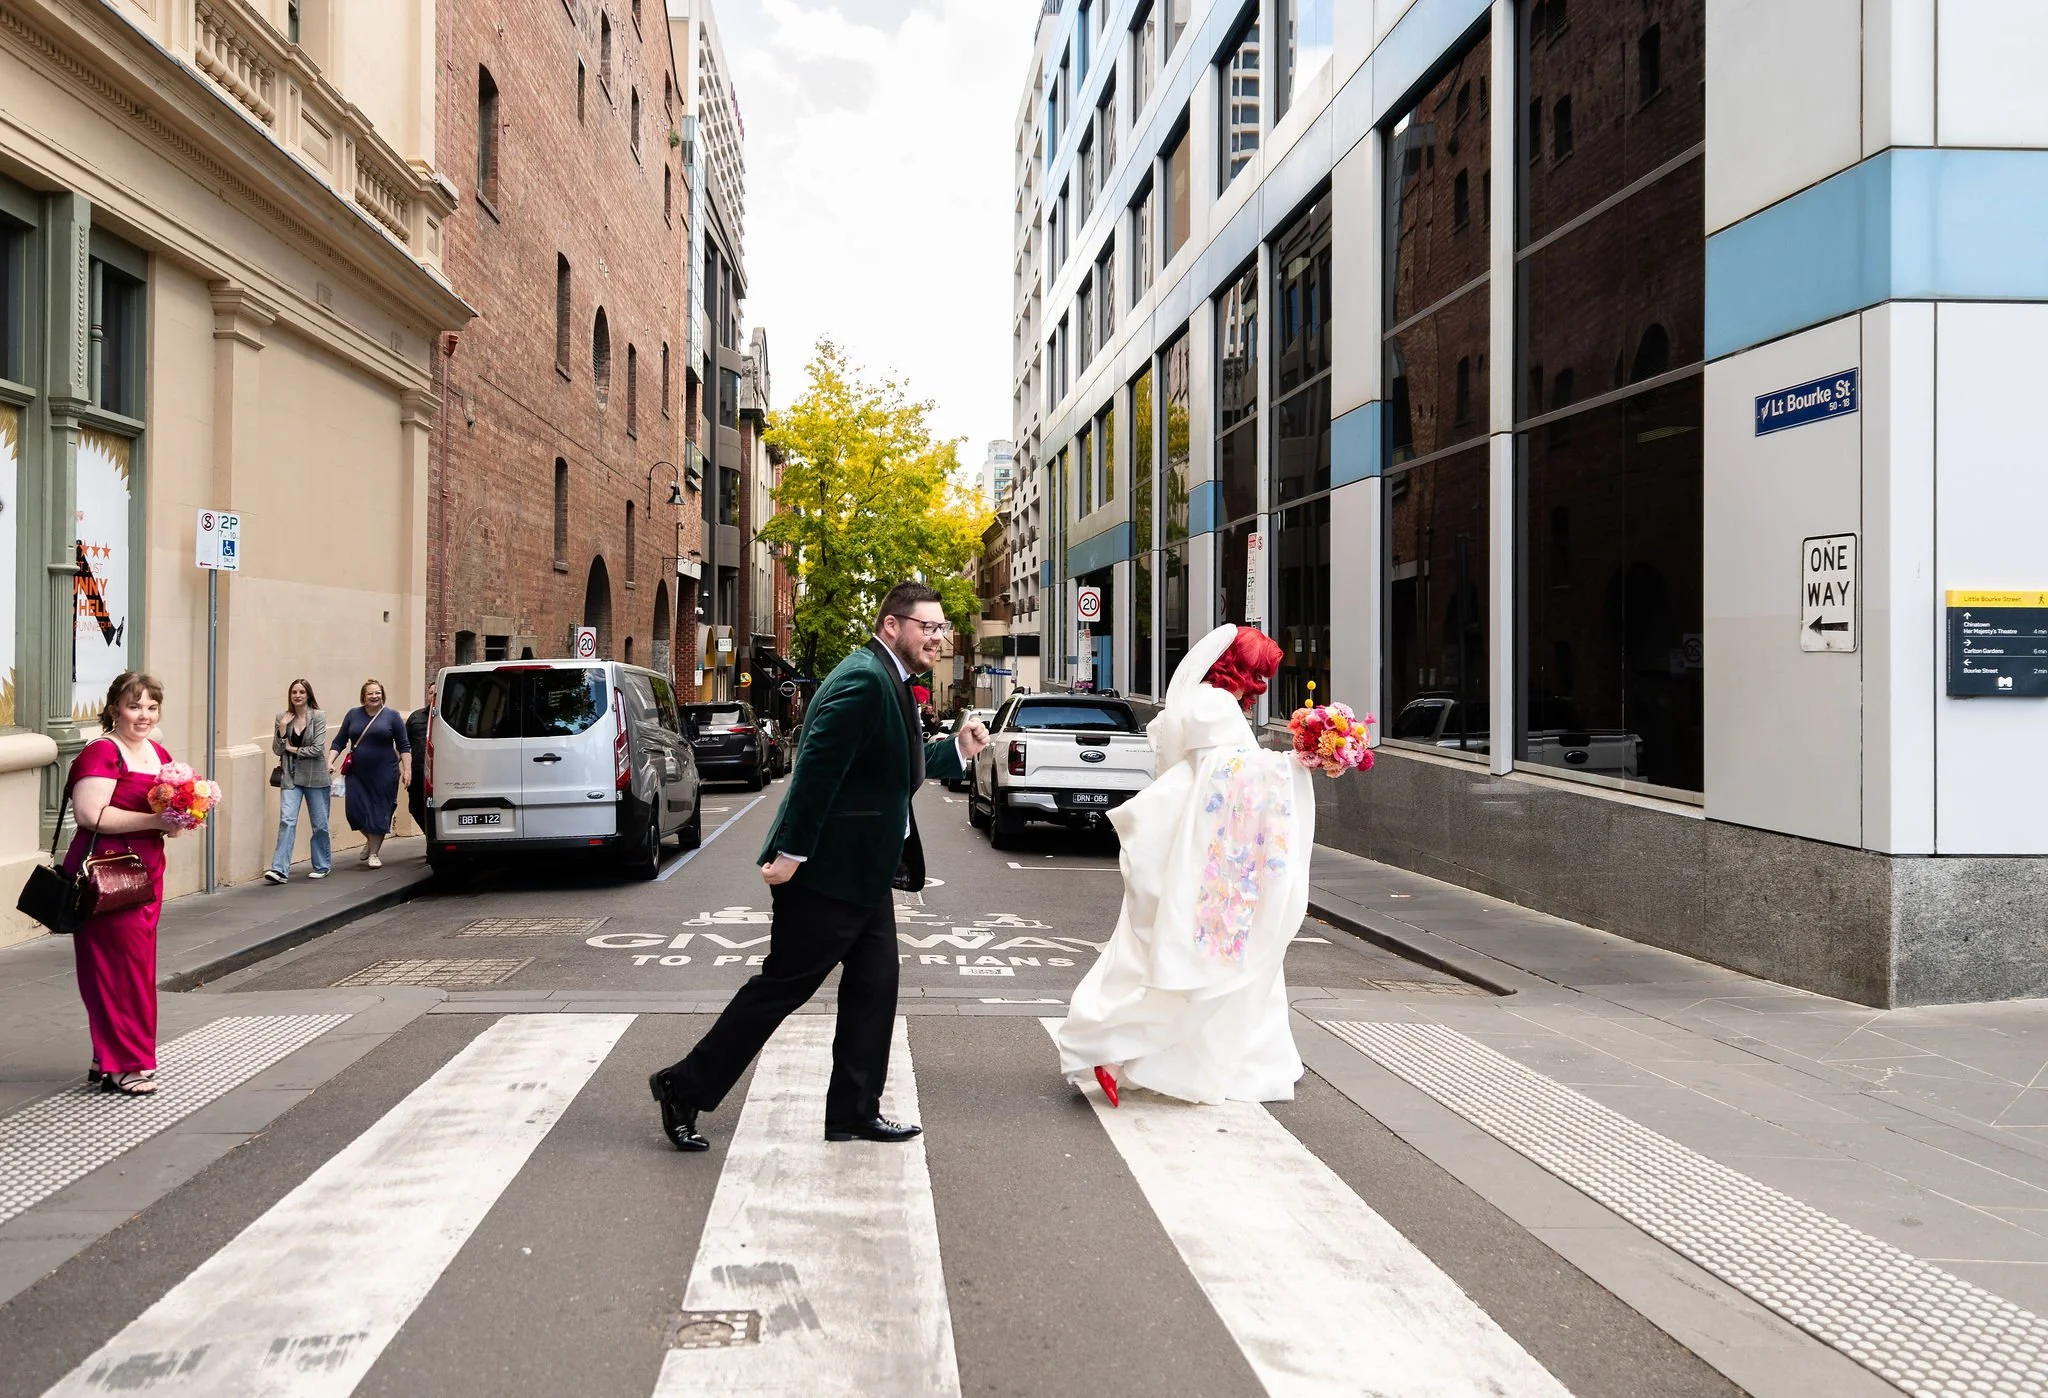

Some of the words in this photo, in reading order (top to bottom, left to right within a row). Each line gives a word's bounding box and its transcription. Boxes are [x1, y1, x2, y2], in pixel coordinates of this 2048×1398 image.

[1771, 398, 1784, 416] Lt
[1787, 386, 1831, 412] Bourke
[1835, 379, 1851, 399] St
[221, 515, 238, 530] 2P
[1810, 545, 1848, 572] ONE
[73, 575, 108, 597] UNNY
[1807, 580, 1851, 607] WAY
[79, 598, 110, 617] HELL
[1082, 598, 1097, 611] 20
[581, 638, 593, 651] 20
[585, 933, 771, 949] GIV
[631, 954, 692, 966] TO
